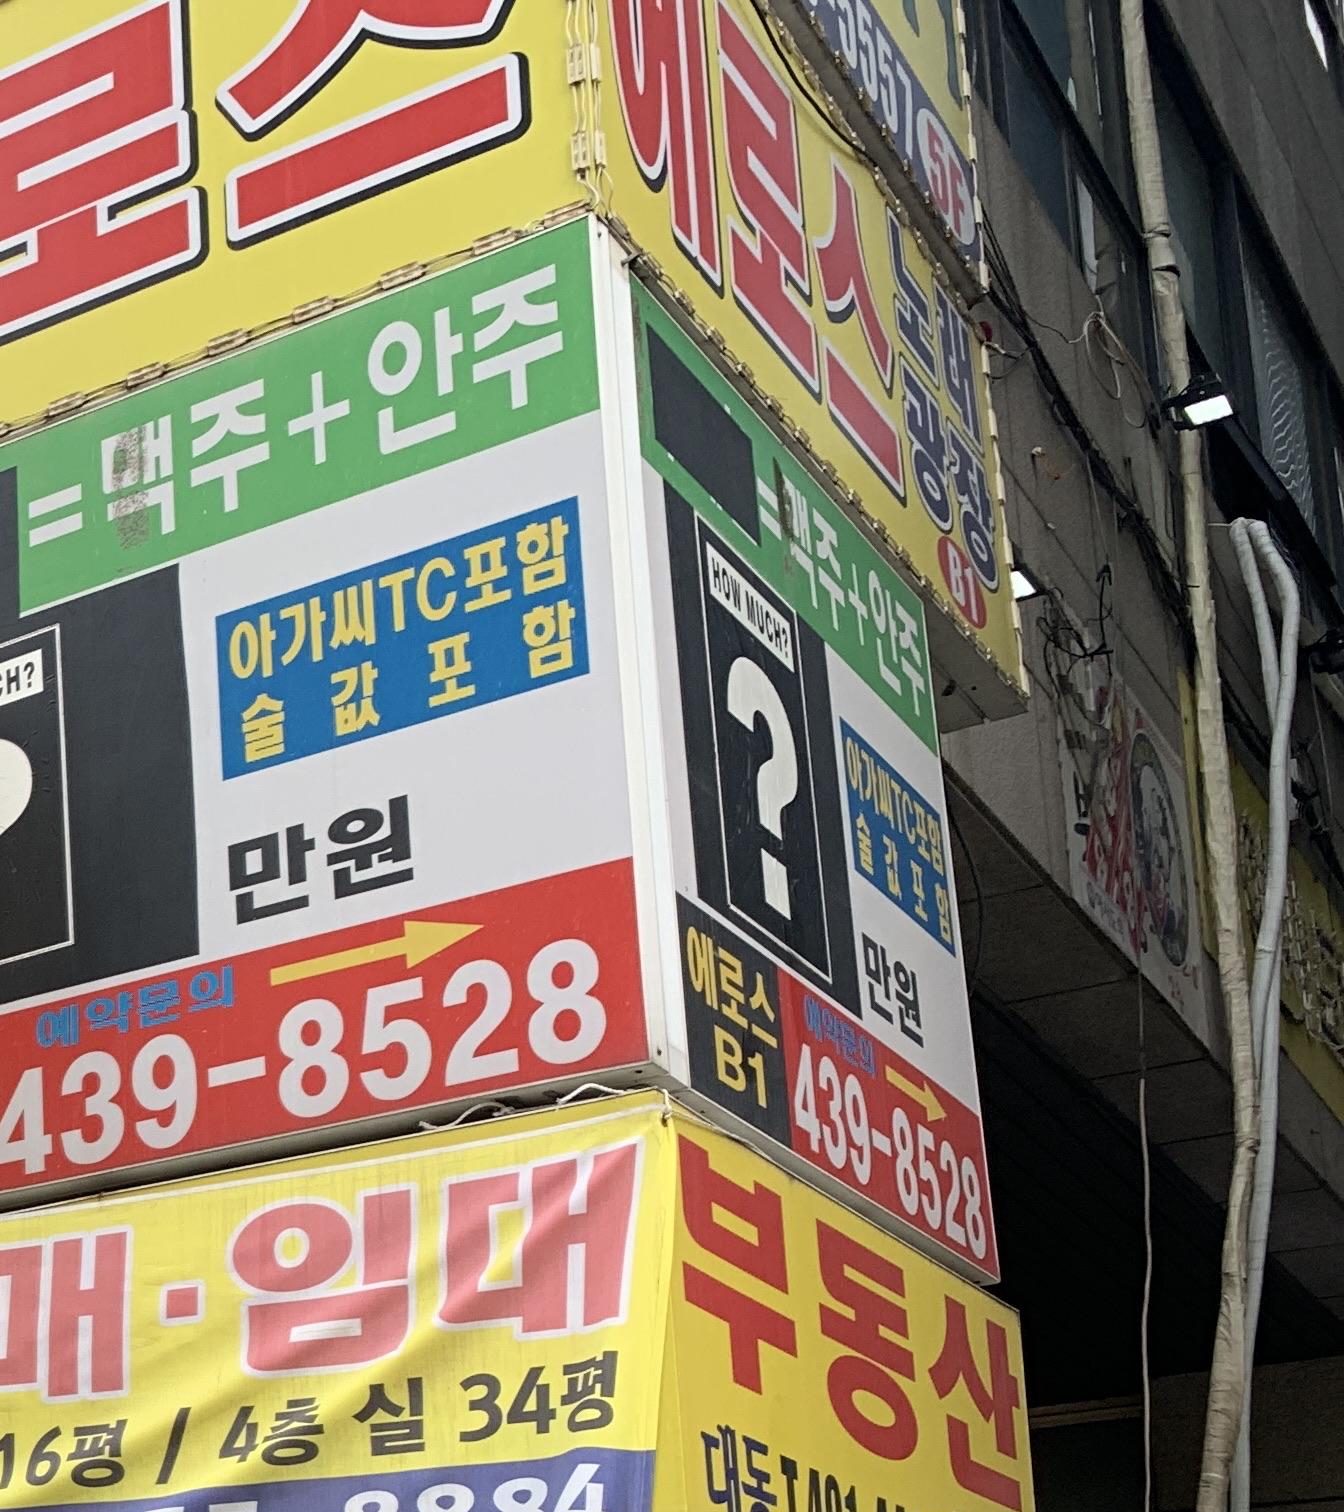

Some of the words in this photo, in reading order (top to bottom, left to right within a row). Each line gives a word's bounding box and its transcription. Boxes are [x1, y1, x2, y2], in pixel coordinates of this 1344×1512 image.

[926, 119, 966, 240] 5F
[228, 518, 570, 682] 아가씨TC포함
[711, 559, 742, 613] HOW
[744, 590, 790, 660] MUCH?
[949, 550, 981, 627] B1
[226, 794, 417, 926] 만원
[36, 964, 236, 1050] 예약문의
[685, 926, 779, 1051] 에로스
[861, 931, 924, 1049] 만원
[713, 1026, 769, 1112] B1
[792, 1042, 988, 1264] 439-8528
[219, 1394, 325, 1468] 4층
[353, 1374, 428, 1456] 실
[458, 1349, 620, 1445] 34평
